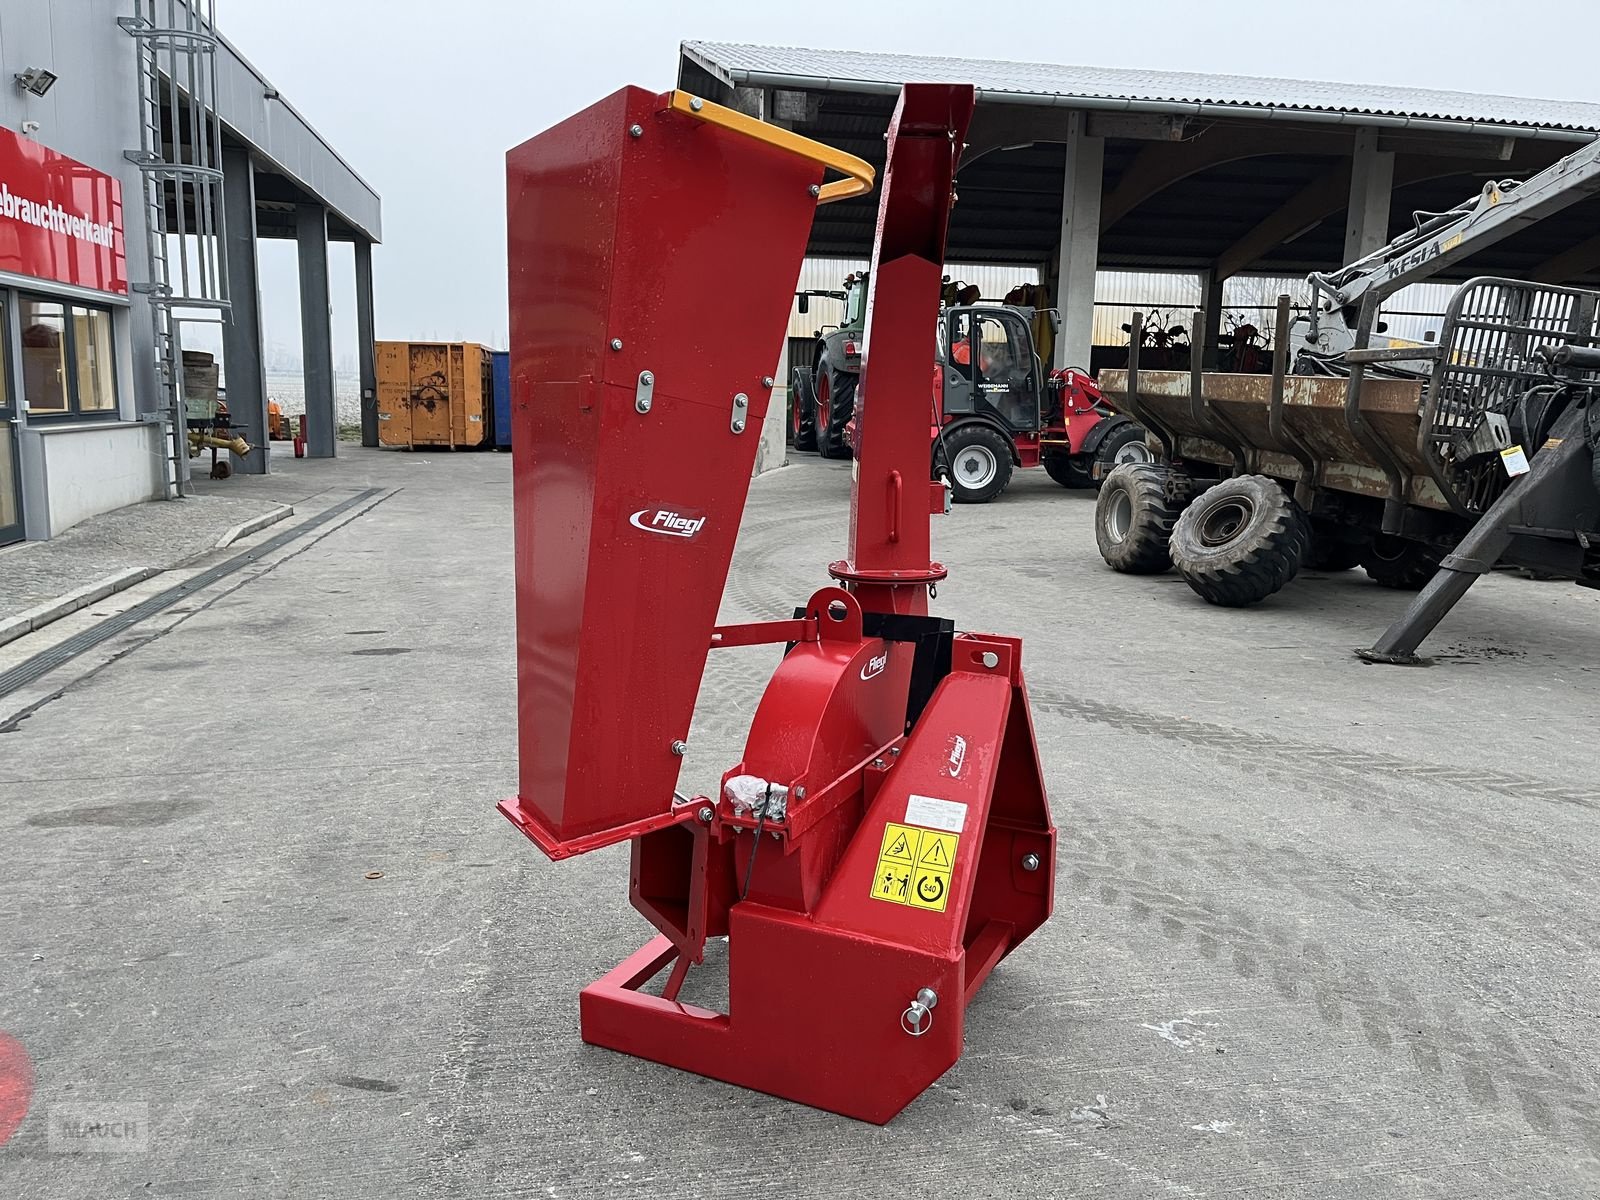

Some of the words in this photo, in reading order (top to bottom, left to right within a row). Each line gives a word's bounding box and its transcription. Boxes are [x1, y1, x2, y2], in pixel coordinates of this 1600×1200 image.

[652, 510, 706, 534] Fliegl
[868, 650, 888, 672] Fliegl
[950, 735, 966, 765] Fliegl
[924, 883, 937, 893] 540
